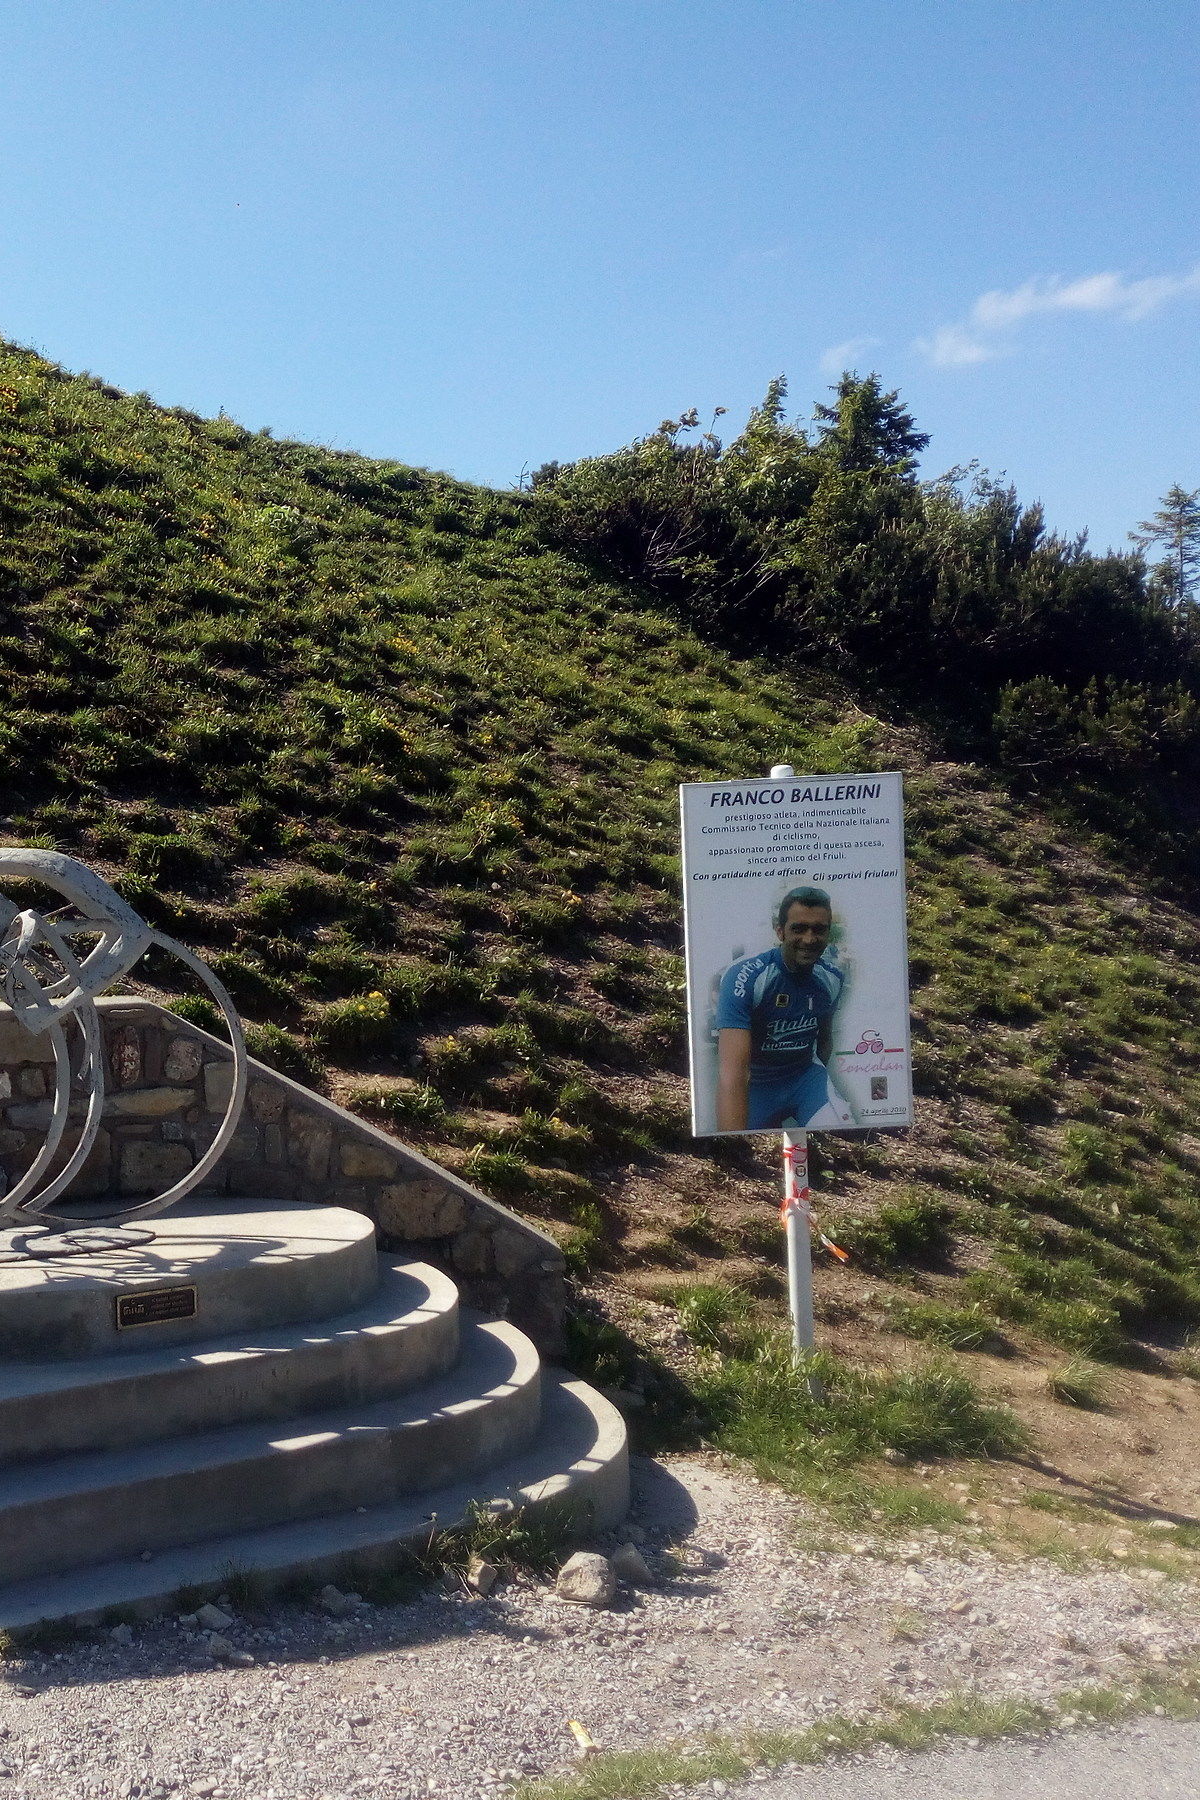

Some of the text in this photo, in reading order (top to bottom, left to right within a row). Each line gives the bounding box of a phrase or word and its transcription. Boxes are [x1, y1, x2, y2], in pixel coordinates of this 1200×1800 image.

[710, 783, 881, 807] FRANCO BALLERINI
[725, 812, 771, 823] prestigioso
[802, 806, 867, 817] indimenticabile
[701, 825, 757, 834] Commissario
[759, 822, 791, 831] Tecnico
[793, 820, 814, 829] della
[816, 818, 857, 828] Nazionale
[783, 832, 820, 841] ciclismo,
[708, 839, 885, 856] appassionato promotore di questa ascesa,
[747, 852, 847, 865] sincero amico del Friuli.
[693, 873, 709, 881] Con
[764, 869, 775, 877] ed
[777, 868, 807, 878] affetto
[812, 868, 898, 882] Gli sportivi friulani
